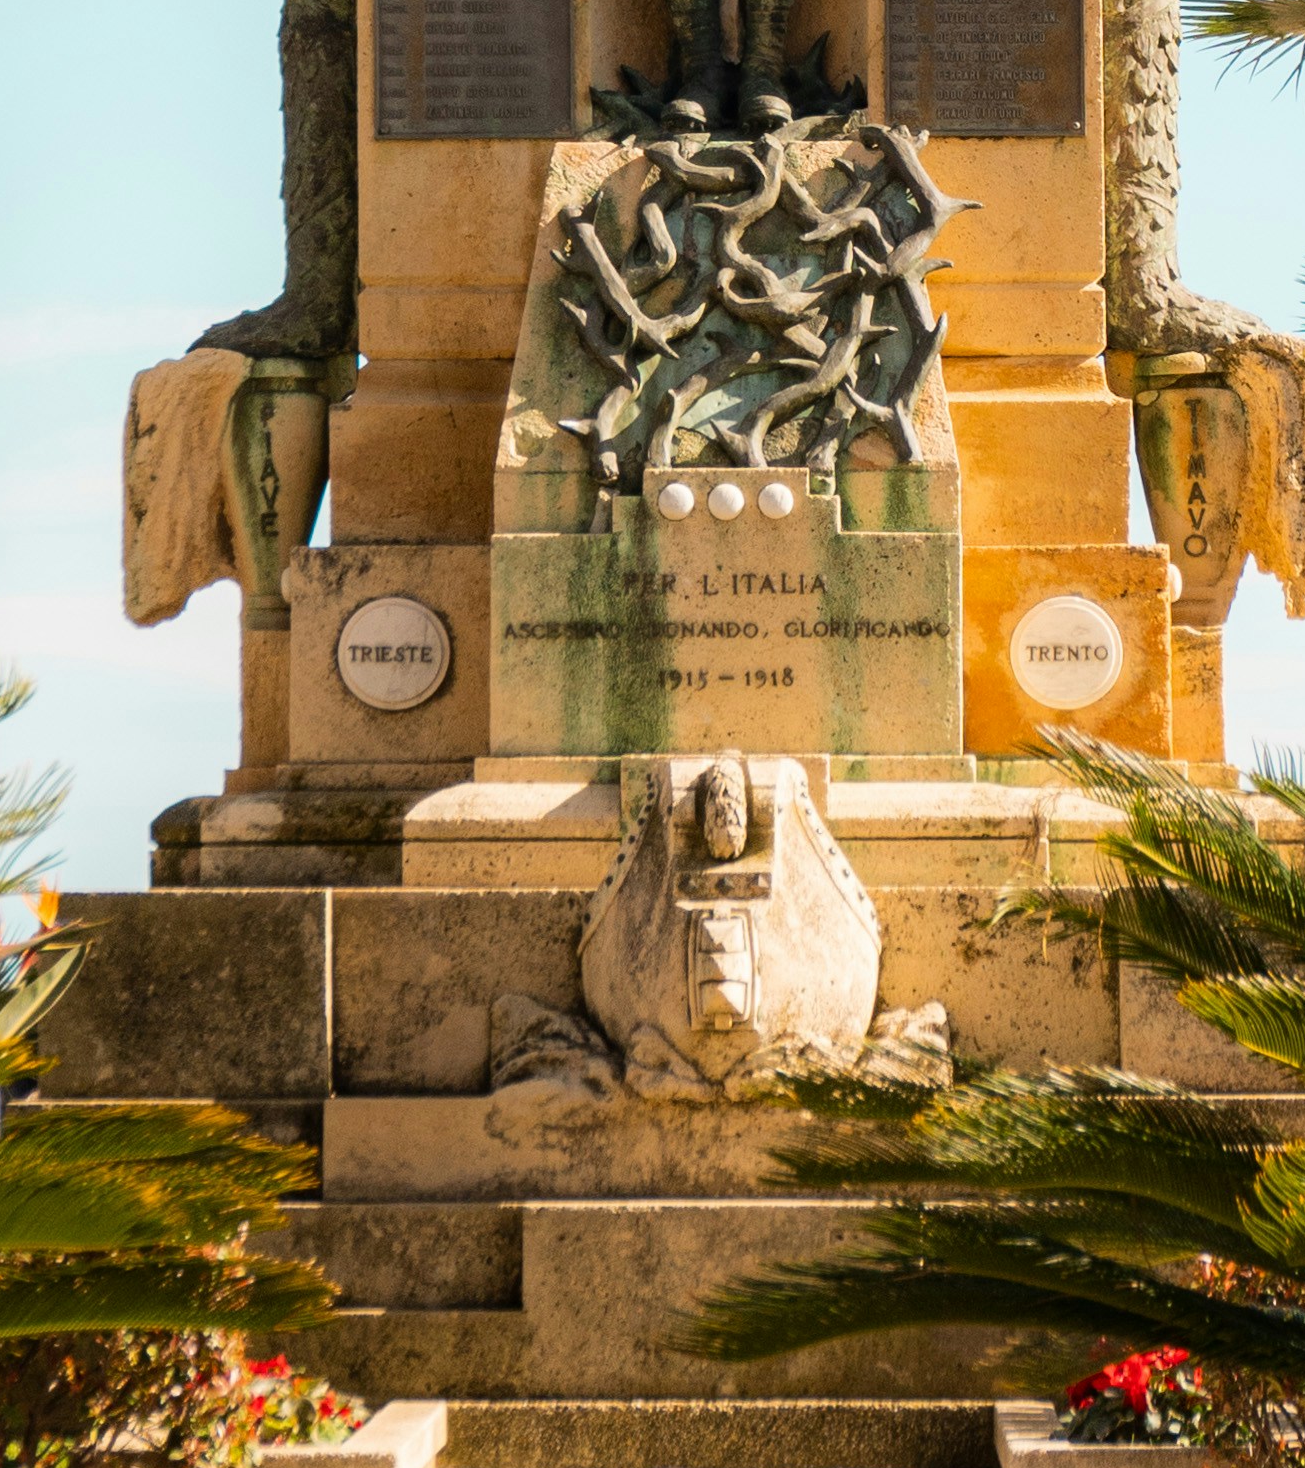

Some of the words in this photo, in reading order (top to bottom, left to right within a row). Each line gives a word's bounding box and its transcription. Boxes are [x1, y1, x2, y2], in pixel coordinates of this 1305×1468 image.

[259, 399, 281, 538] PIAVE
[1183, 398, 1208, 558] TIMAVO
[623, 571, 678, 595] PER
[783, 617, 951, 641] GLORIFICANDO
[347, 644, 433, 665] TRIESTE
[1025, 644, 1109, 663] TRENTO
[658, 669, 709, 692] 1915
[744, 666, 795, 691] 1918
